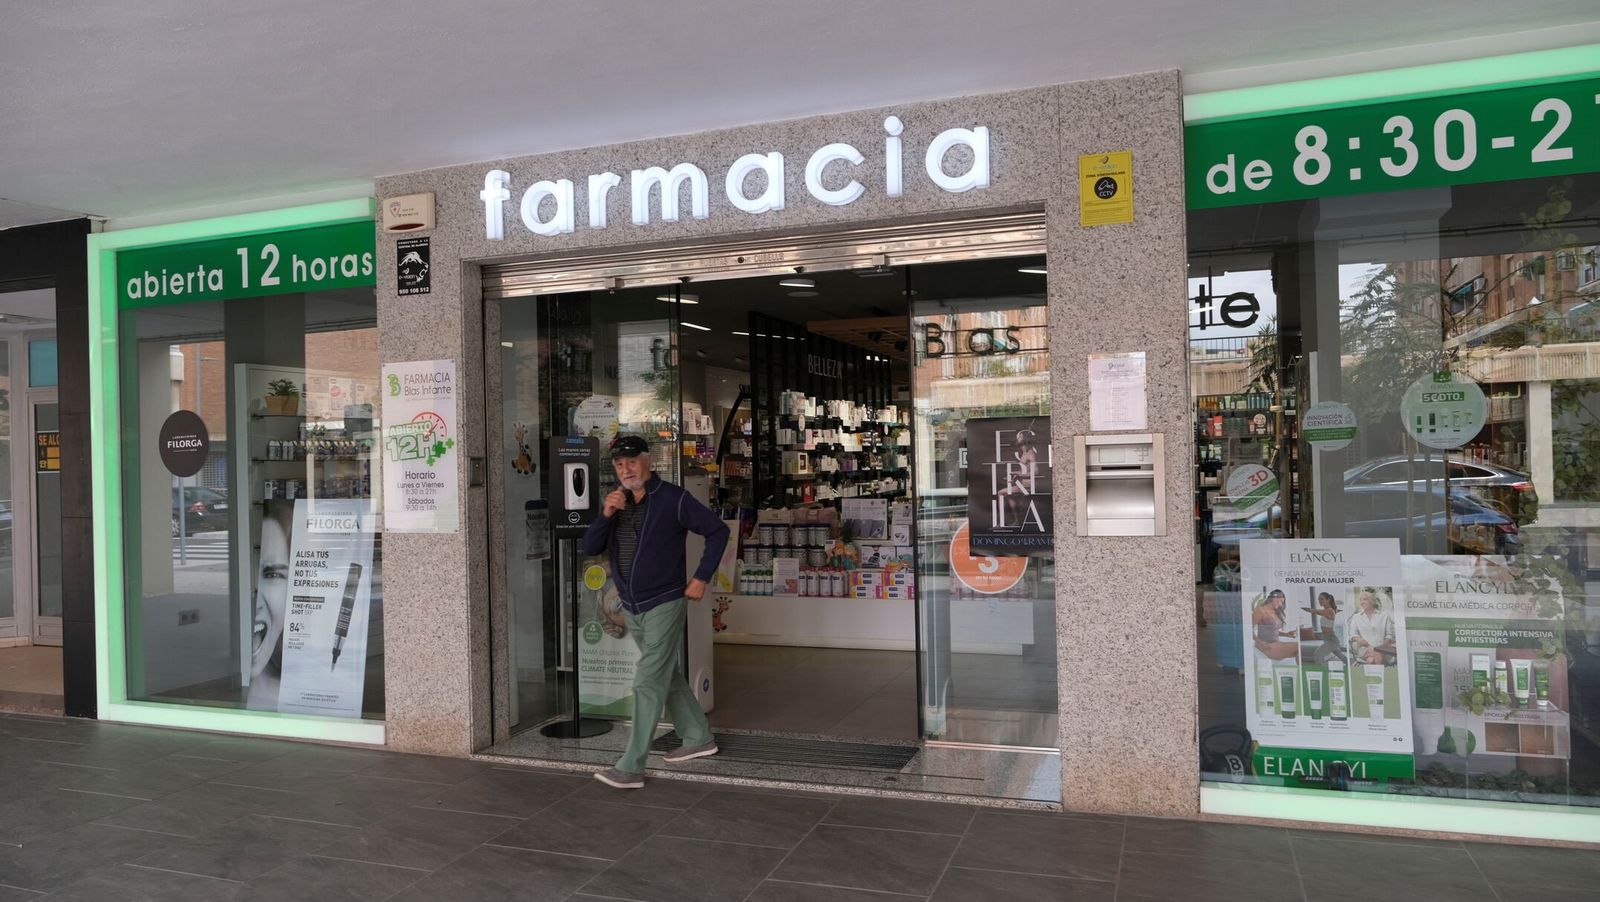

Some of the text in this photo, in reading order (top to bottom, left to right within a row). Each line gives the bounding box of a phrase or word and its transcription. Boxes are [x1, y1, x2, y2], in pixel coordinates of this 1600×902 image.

[1205, 95, 1600, 195] de 8:30-2
[479, 115, 991, 240] farmacia
[126, 243, 373, 300] abierta 12 horas
[925, 315, 1020, 358] Blas
[808, 353, 843, 378] BELLEZA
[404, 372, 451, 384] FARMACIA
[404, 385, 452, 396] Blas Infante
[389, 421, 433, 436] ABIERTO
[38, 434, 48, 446] SE
[167, 439, 203, 449] FILORGA
[405, 471, 436, 480] Horario
[1247, 470, 1269, 487] 3D
[306, 518, 361, 530] FILORGA
[296, 550, 330, 559] ALISA TUS
[1290, 552, 1347, 563] ELANCYL
[295, 561, 329, 569] ARRUGAS,
[305, 570, 318, 578] TUS
[293, 580, 340, 588] EXPRESIONES
[1435, 580, 1514, 595] ELANCYL
[1407, 600, 1457, 609] COSMÉTICA
[1458, 601, 1495, 610] MÉDICA
[1454, 629, 1554, 639] CORRECTORA INTENSIVA
[1410, 639, 1443, 648] ELANCYL
[1454, 636, 1508, 645] ANTIESTRÍAS
[581, 665, 633, 674] CLIMATE NEUTRAL
[1229, 758, 1242, 771] 8
